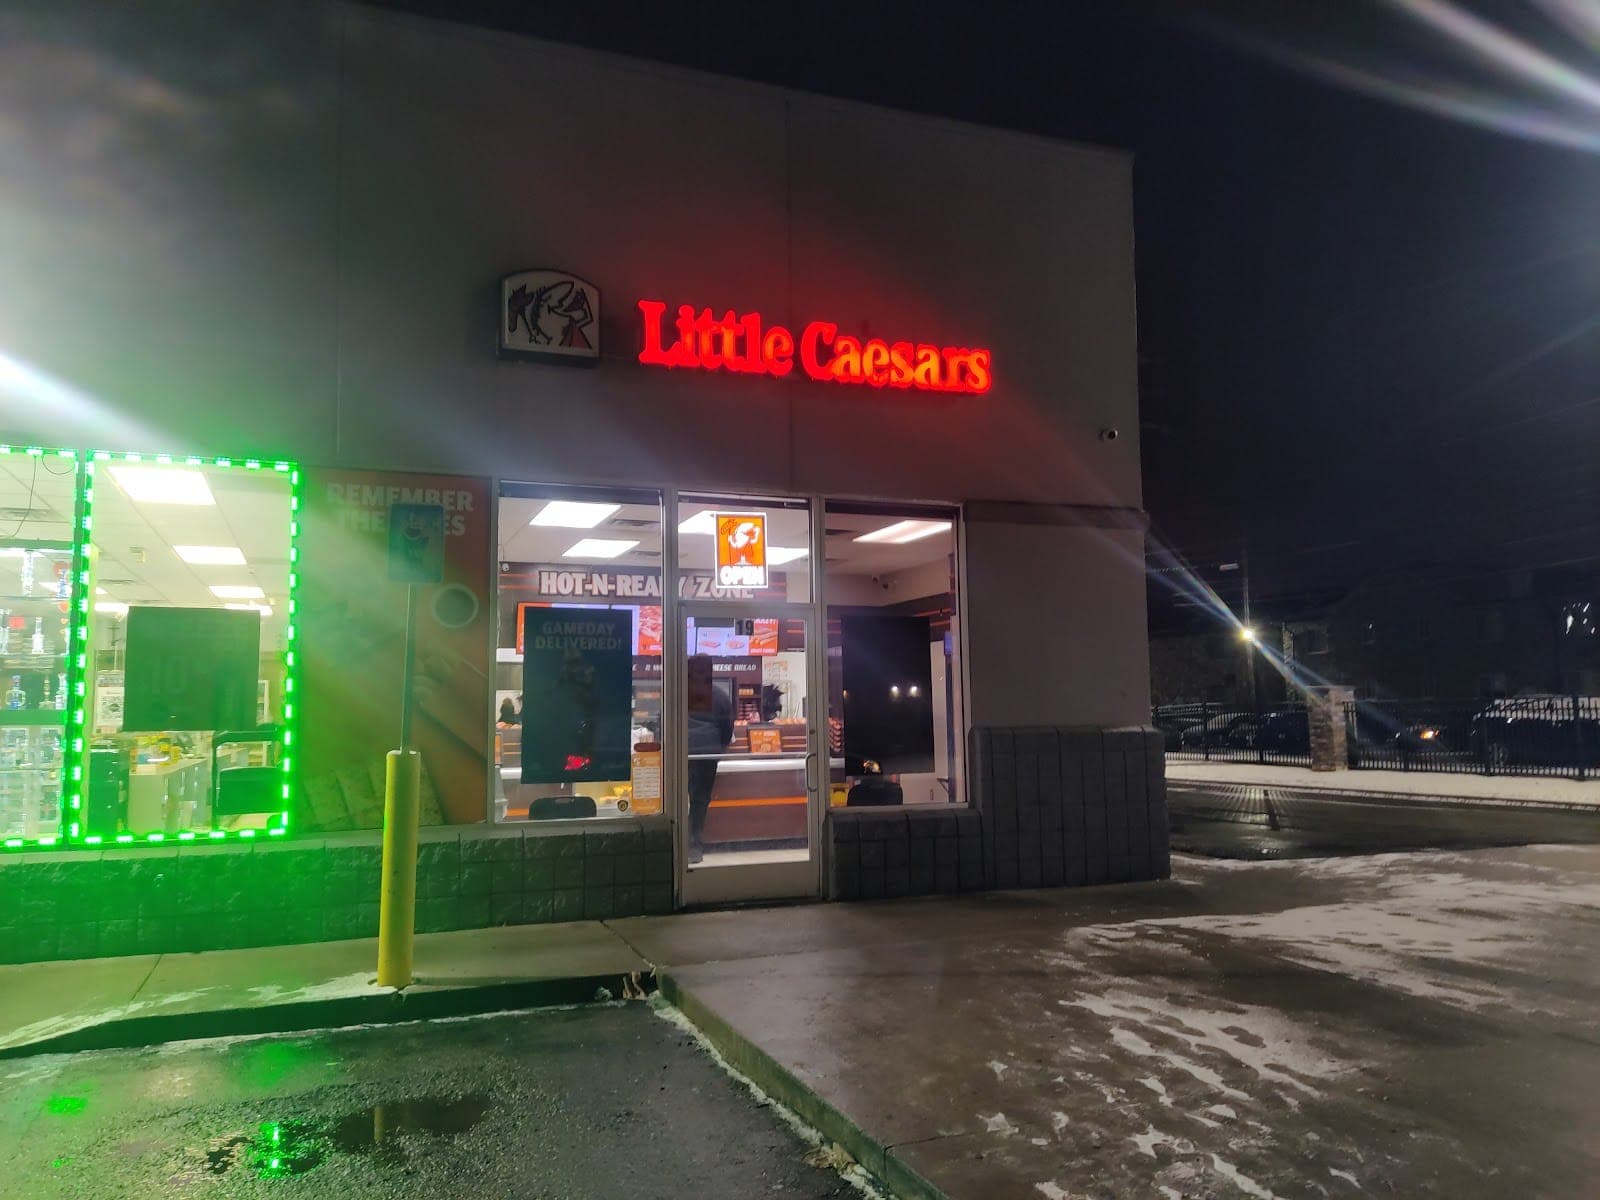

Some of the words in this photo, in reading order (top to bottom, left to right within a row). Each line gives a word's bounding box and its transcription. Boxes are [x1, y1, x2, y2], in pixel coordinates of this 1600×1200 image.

[639, 301, 794, 376] Little
[801, 321, 992, 393] Caesars
[327, 482, 474, 512] REMEMBER
[720, 565, 765, 585] OPEN
[543, 621, 616, 635] GAMEDAY
[535, 635, 623, 650] DELIVERED!
